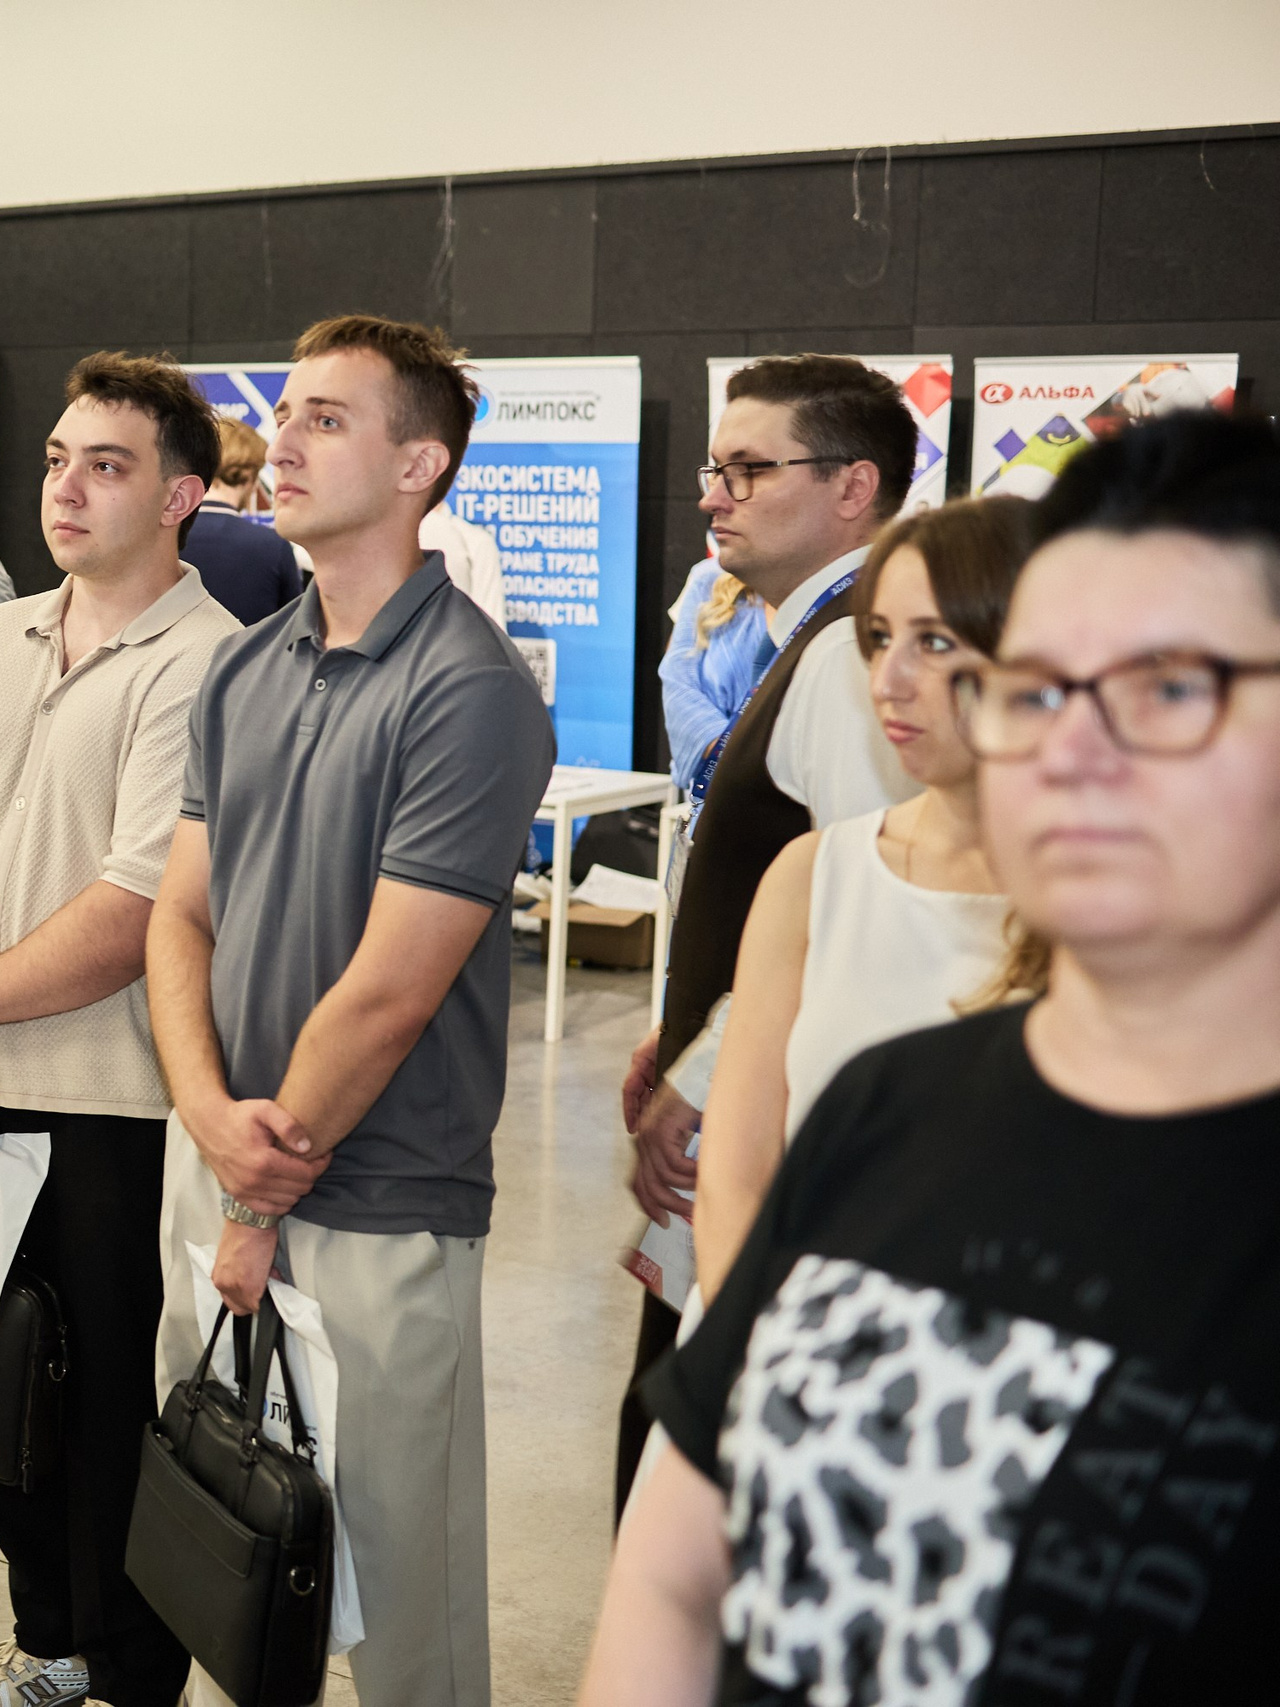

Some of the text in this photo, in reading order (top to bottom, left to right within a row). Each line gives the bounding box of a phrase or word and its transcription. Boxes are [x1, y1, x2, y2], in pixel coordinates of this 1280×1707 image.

[1019, 385, 1095, 399] АЛЬФА
[497, 401, 596, 421] ЛИМПОКС
[455, 465, 601, 492] ЭКОСИСТЕМА
[456, 491, 600, 524] IT-РЕШЕНИЙ
[499, 525, 599, 550] ОБУЧЕНИЯ
[500, 551, 599, 576] РАНЕ ТРУДА
[503, 575, 599, 599] ОПАСНОСТИ
[505, 600, 599, 627] ЗВОДСТВА
